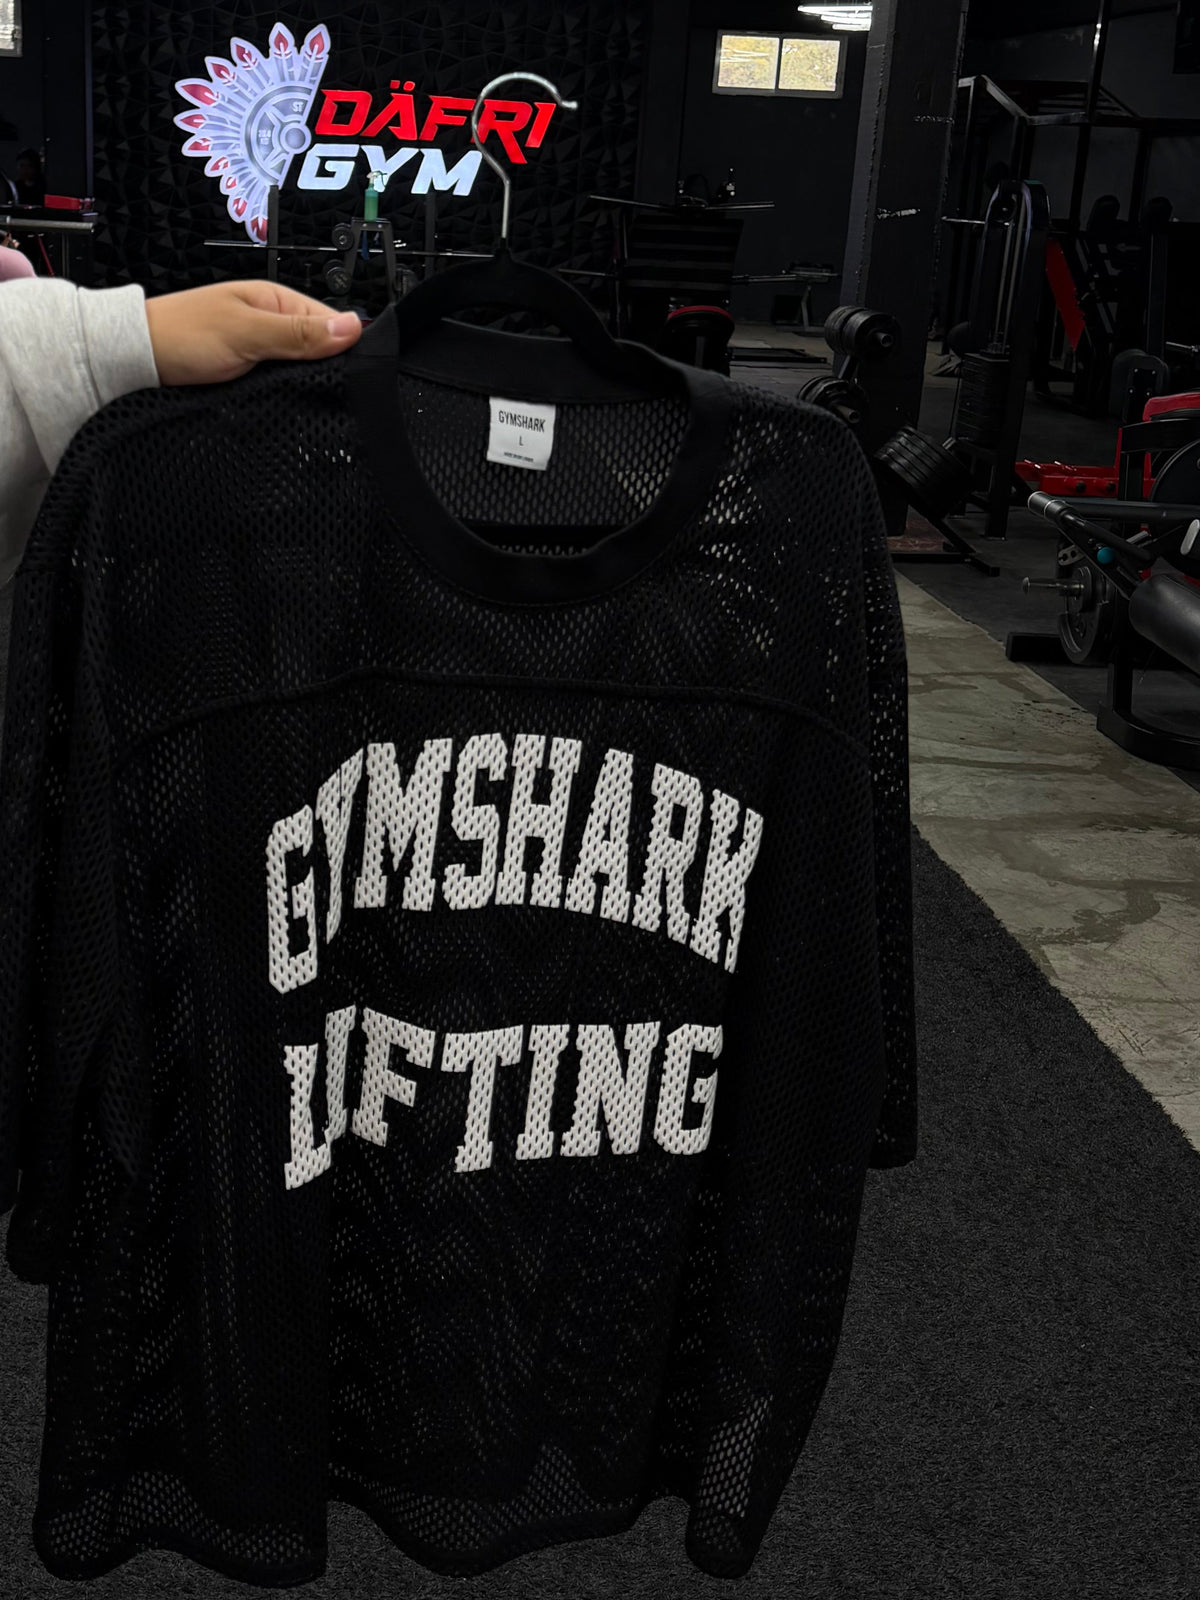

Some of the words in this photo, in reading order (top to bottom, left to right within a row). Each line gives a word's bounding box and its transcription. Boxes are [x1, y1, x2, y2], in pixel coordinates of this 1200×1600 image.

[314, 80, 556, 164] DÄFRI
[297, 143, 483, 196] GYM
[498, 410, 545, 432] GYMSHARK
[518, 435, 524, 446] L
[266, 733, 763, 993] GYMSHARK
[284, 1006, 723, 1190] LIFTING
